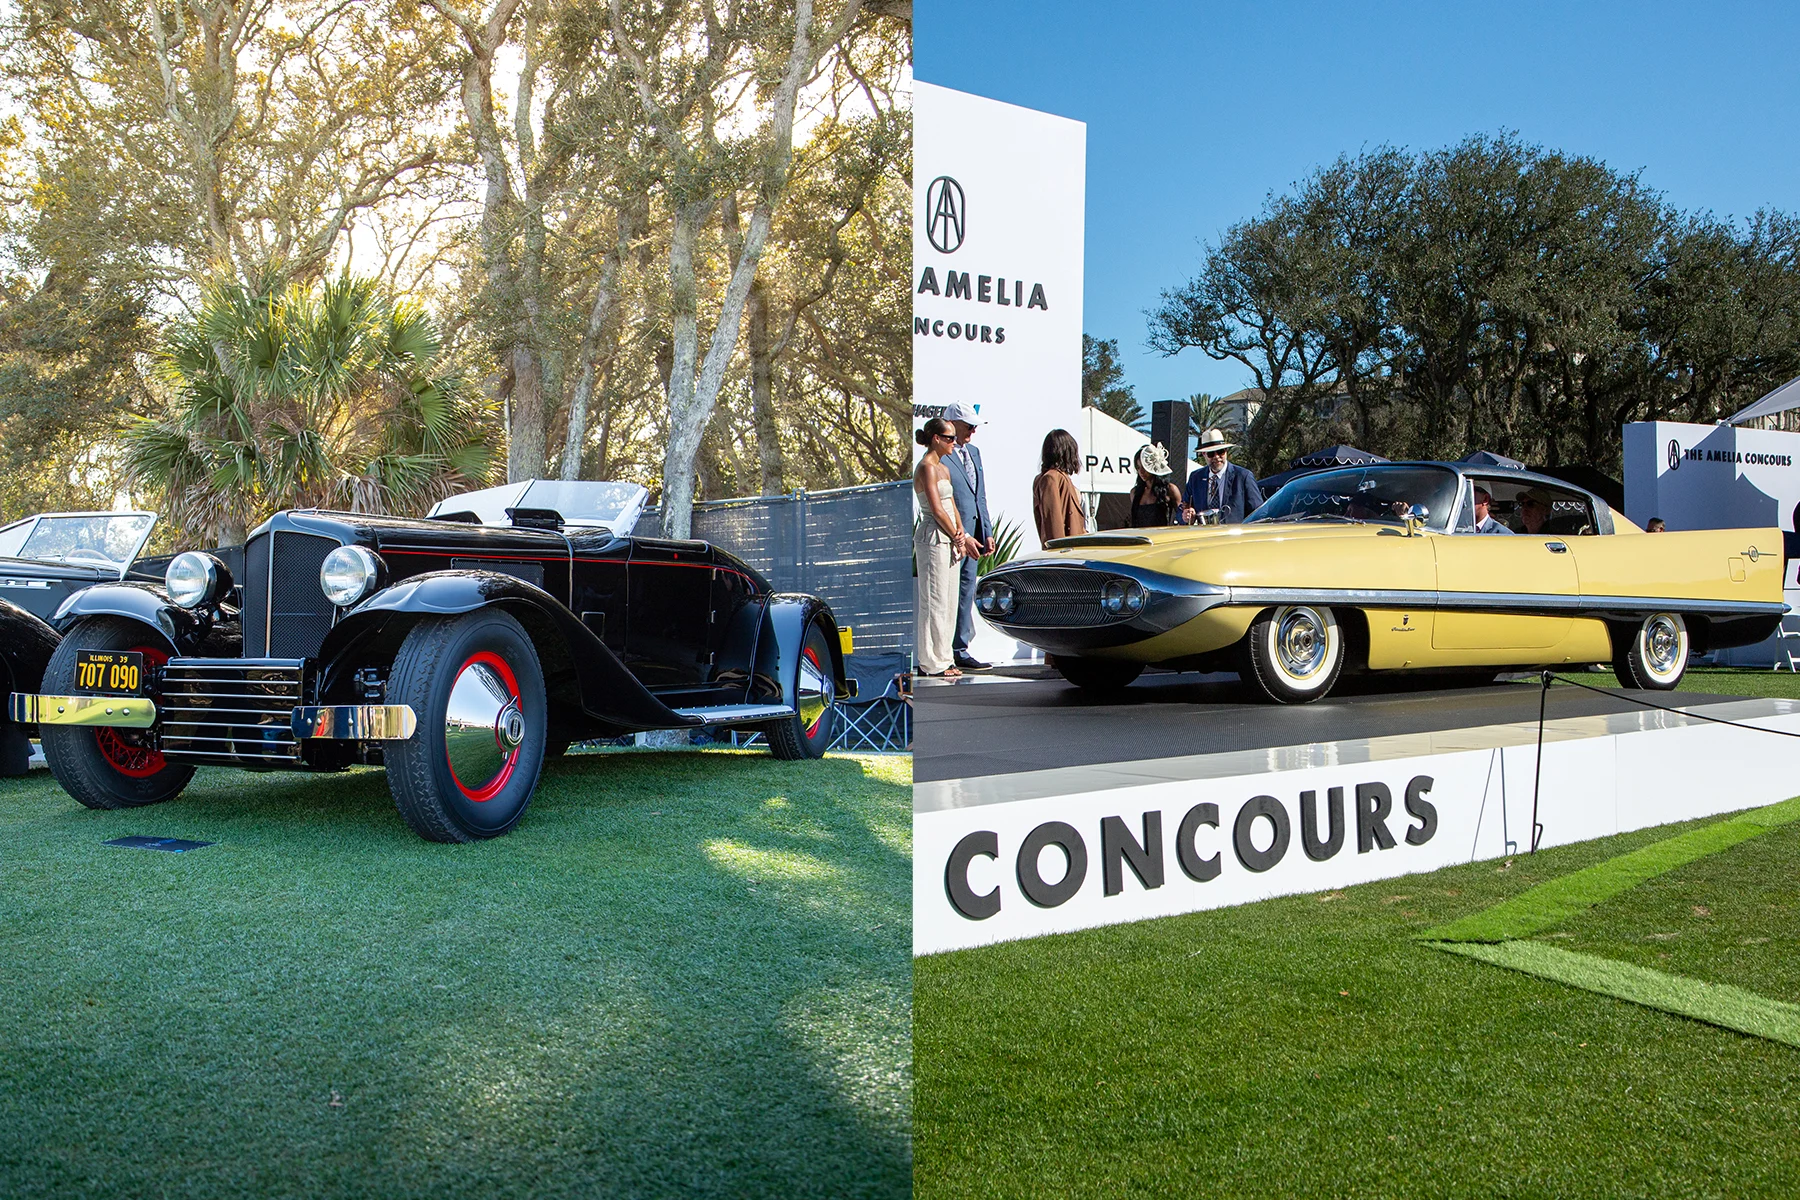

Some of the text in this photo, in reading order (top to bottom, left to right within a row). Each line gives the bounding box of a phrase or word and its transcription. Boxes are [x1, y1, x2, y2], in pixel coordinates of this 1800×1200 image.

[917, 266, 1048, 311] AMELIA
[914, 316, 1006, 344] NCOURS
[1085, 455, 1131, 473] PAR
[1684, 449, 1791, 466] THE AMELIA CONCOURS
[79, 662, 138, 689] 707 090
[945, 775, 1438, 920] CONCOURS
